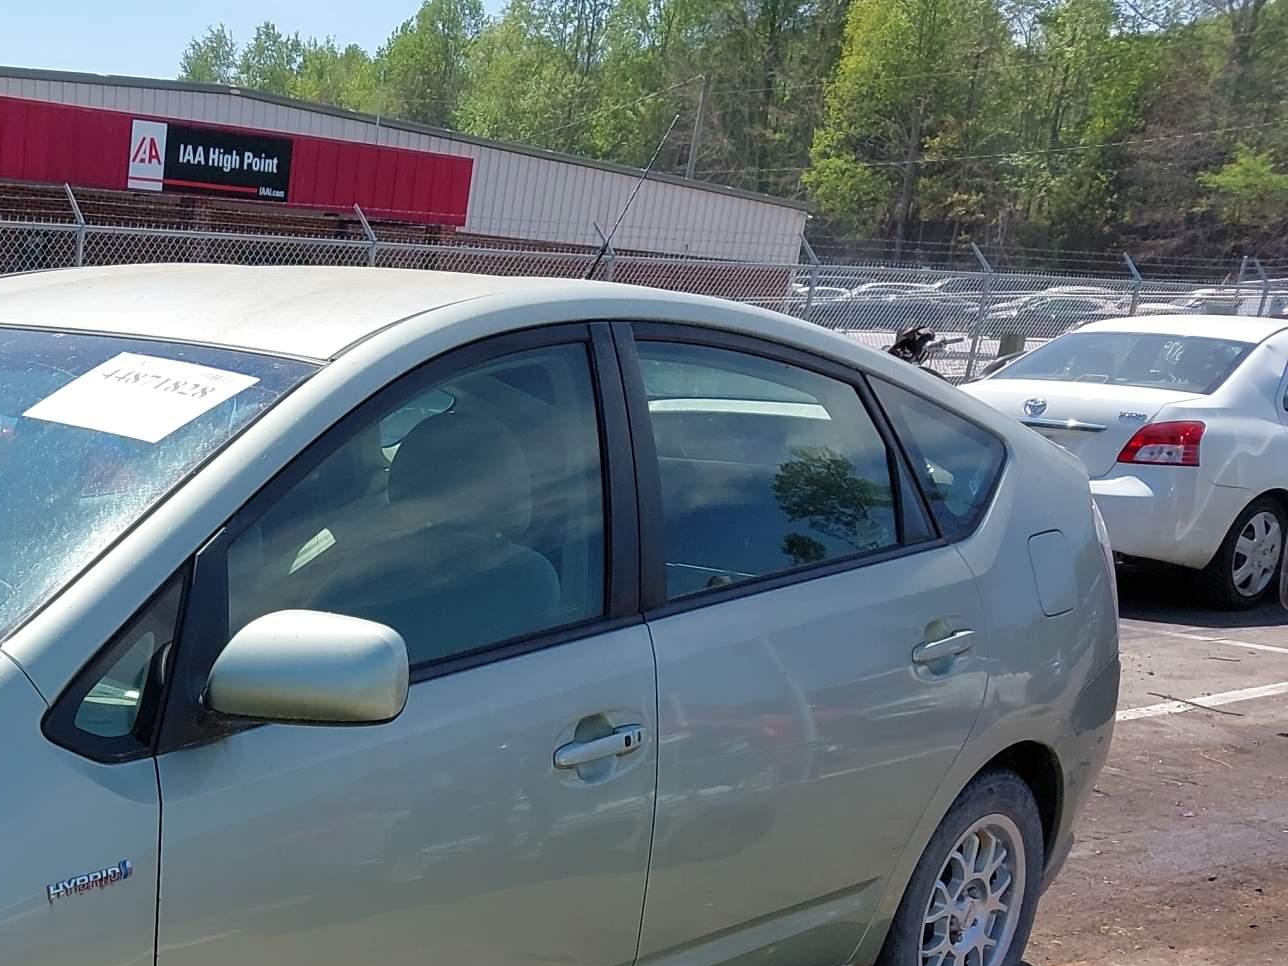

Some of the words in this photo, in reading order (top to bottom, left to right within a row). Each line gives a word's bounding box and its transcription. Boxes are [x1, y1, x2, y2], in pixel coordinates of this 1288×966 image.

[179, 144, 205, 165] IAA
[209, 147, 240, 172] High
[243, 151, 279, 173] Point
[101, 369, 216, 399] 44871828
[47, 866, 120, 903] HYBRID
